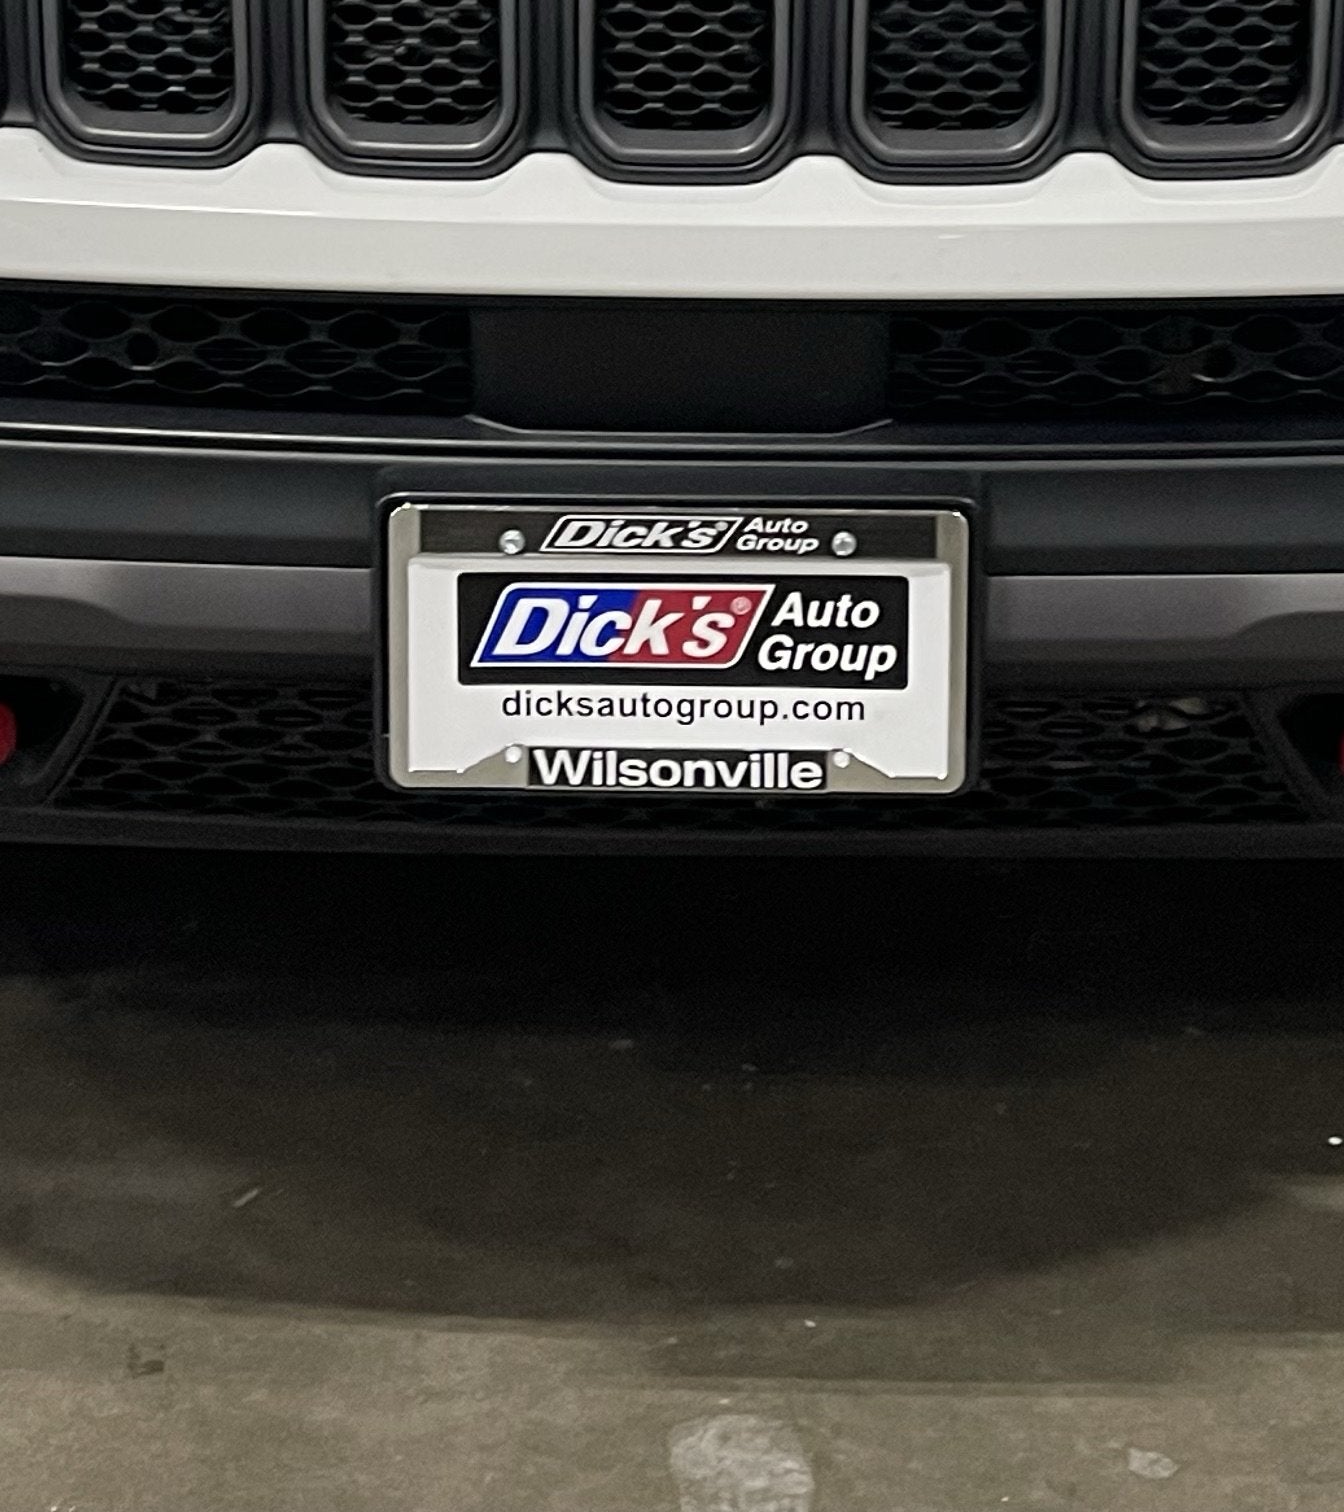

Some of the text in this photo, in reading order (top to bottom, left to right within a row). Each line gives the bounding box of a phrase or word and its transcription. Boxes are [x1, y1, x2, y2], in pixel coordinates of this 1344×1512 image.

[553, 516, 809, 550] Dick's Auto
[735, 534, 820, 555] Group
[492, 592, 880, 658] Dick's Auto
[758, 635, 897, 681] Group
[501, 689, 866, 726] dicksautogroup.com
[532, 748, 824, 789] Wilsonville
